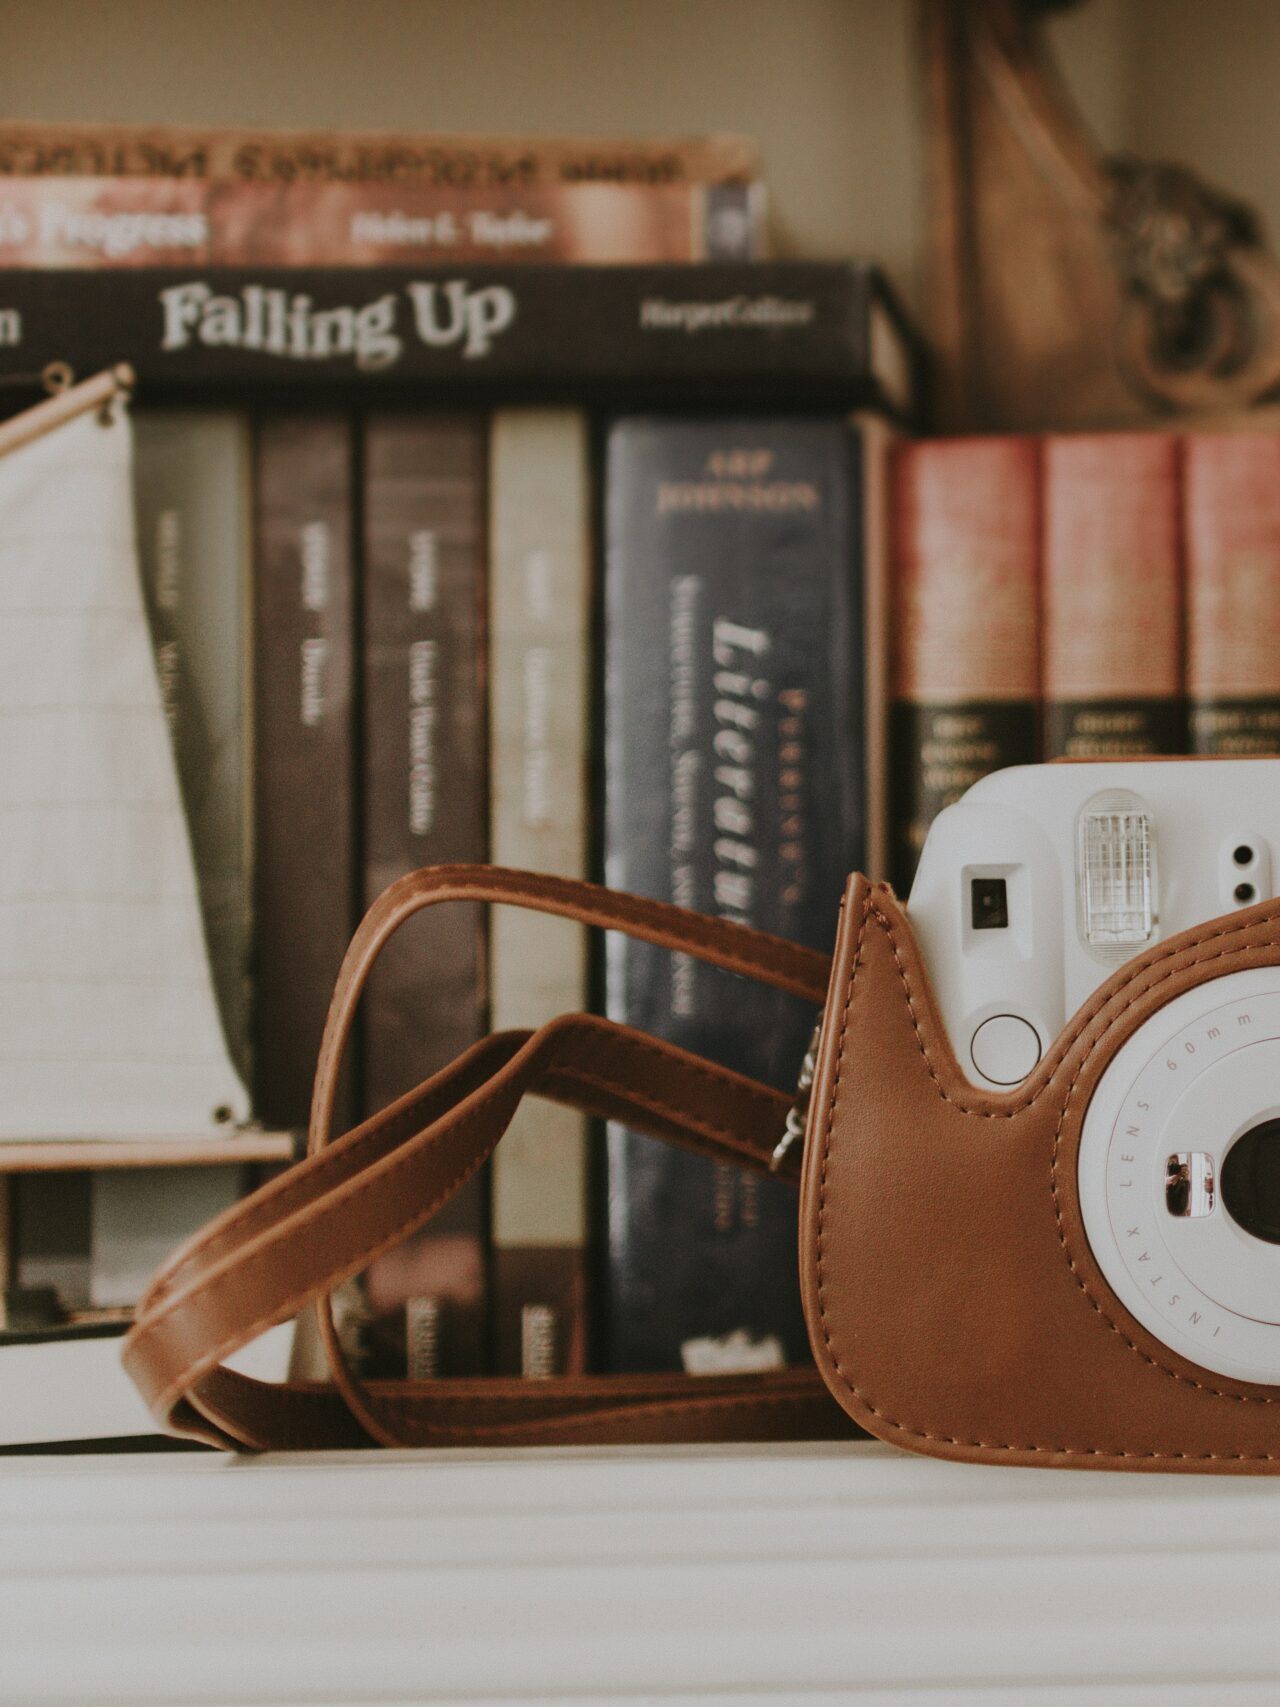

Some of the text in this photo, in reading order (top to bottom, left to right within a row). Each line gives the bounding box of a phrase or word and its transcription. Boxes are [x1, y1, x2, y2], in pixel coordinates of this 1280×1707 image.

[161, 282, 515, 369] Falling Up
[1166, 1013, 1252, 1072] 60mm
[1120, 1100, 1150, 1188] LENS
[1127, 1226, 1221, 1338] INSTAX
